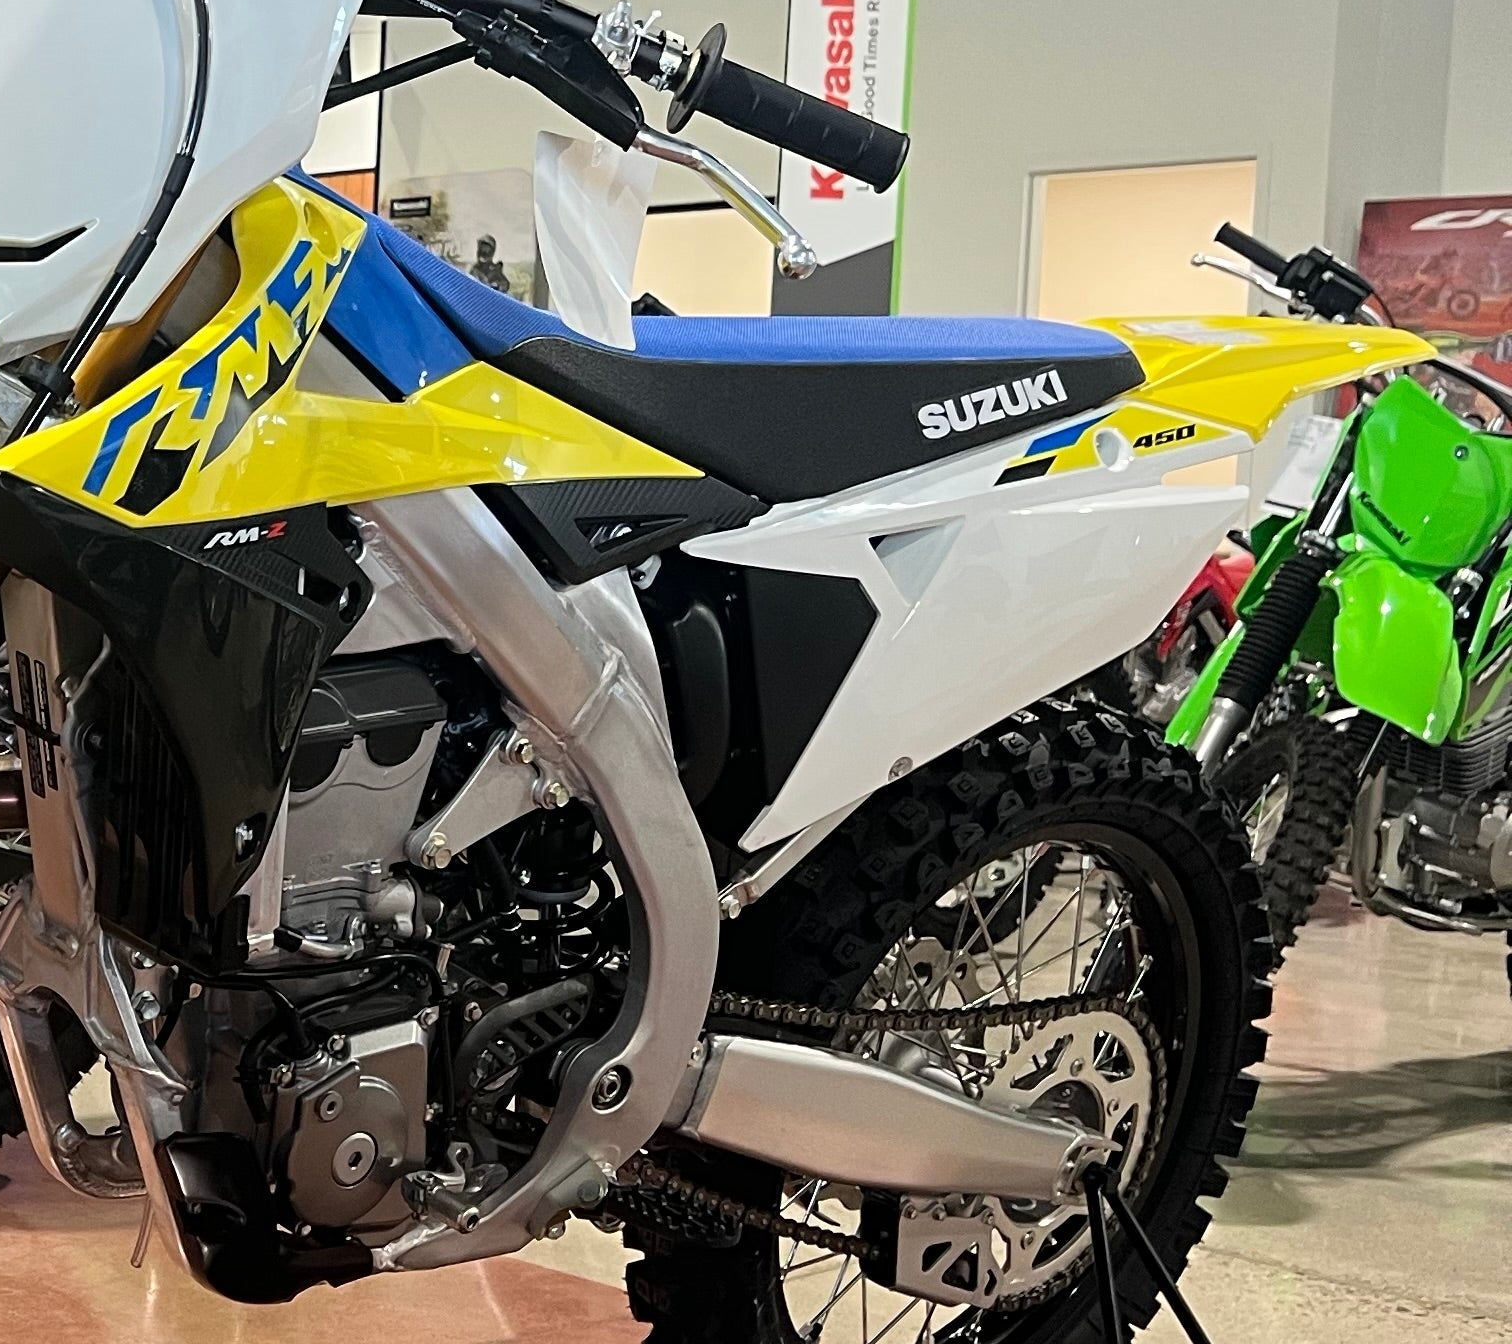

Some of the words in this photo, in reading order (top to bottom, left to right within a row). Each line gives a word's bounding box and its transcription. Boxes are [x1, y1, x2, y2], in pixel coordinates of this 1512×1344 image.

[863, 18, 879, 73] Times
[917, 369, 1069, 440] SUZUKI
[1132, 423, 1196, 449] 450
[203, 520, 288, 550] RM-Z
